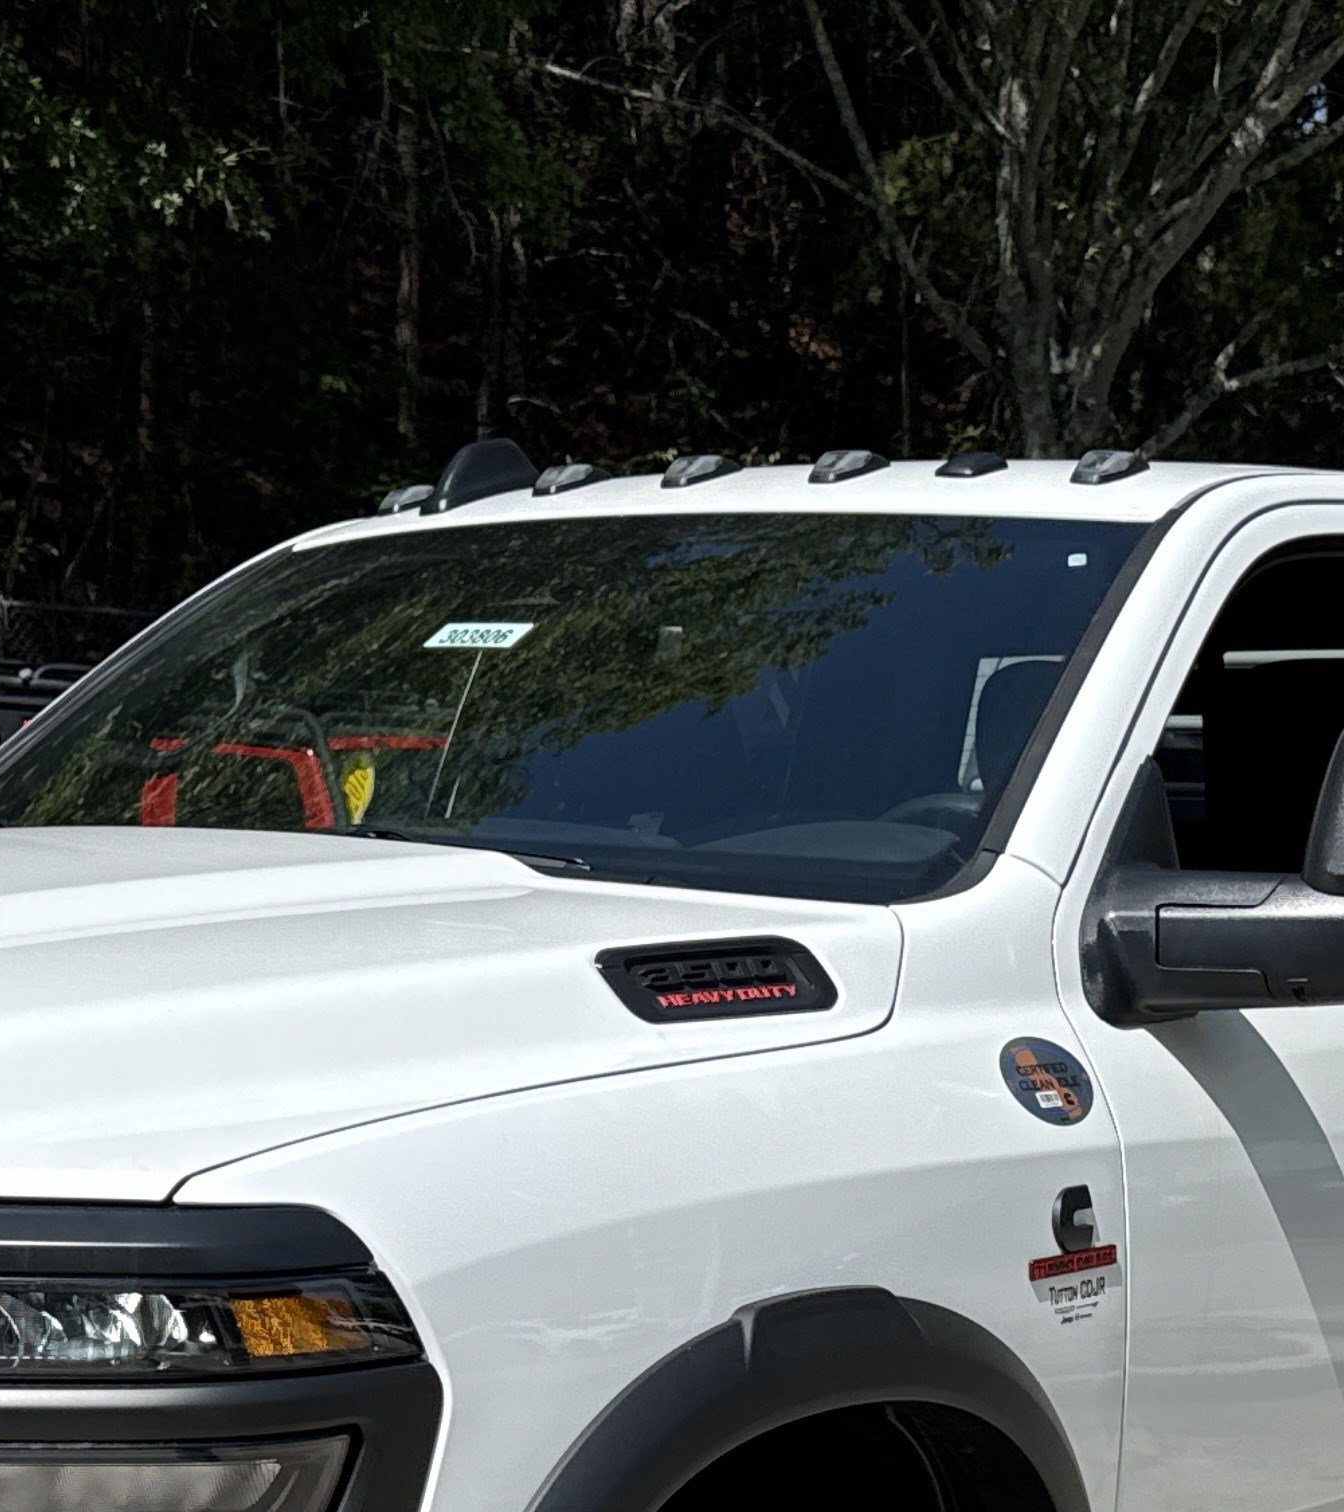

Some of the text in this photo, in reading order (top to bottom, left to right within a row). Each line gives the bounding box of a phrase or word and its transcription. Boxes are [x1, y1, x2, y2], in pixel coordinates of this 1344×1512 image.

[657, 983, 797, 1010] HEAVY DUTY
[1015, 1061, 1069, 1077] CERTIFIED
[1019, 1077, 1056, 1092] CLEAN
